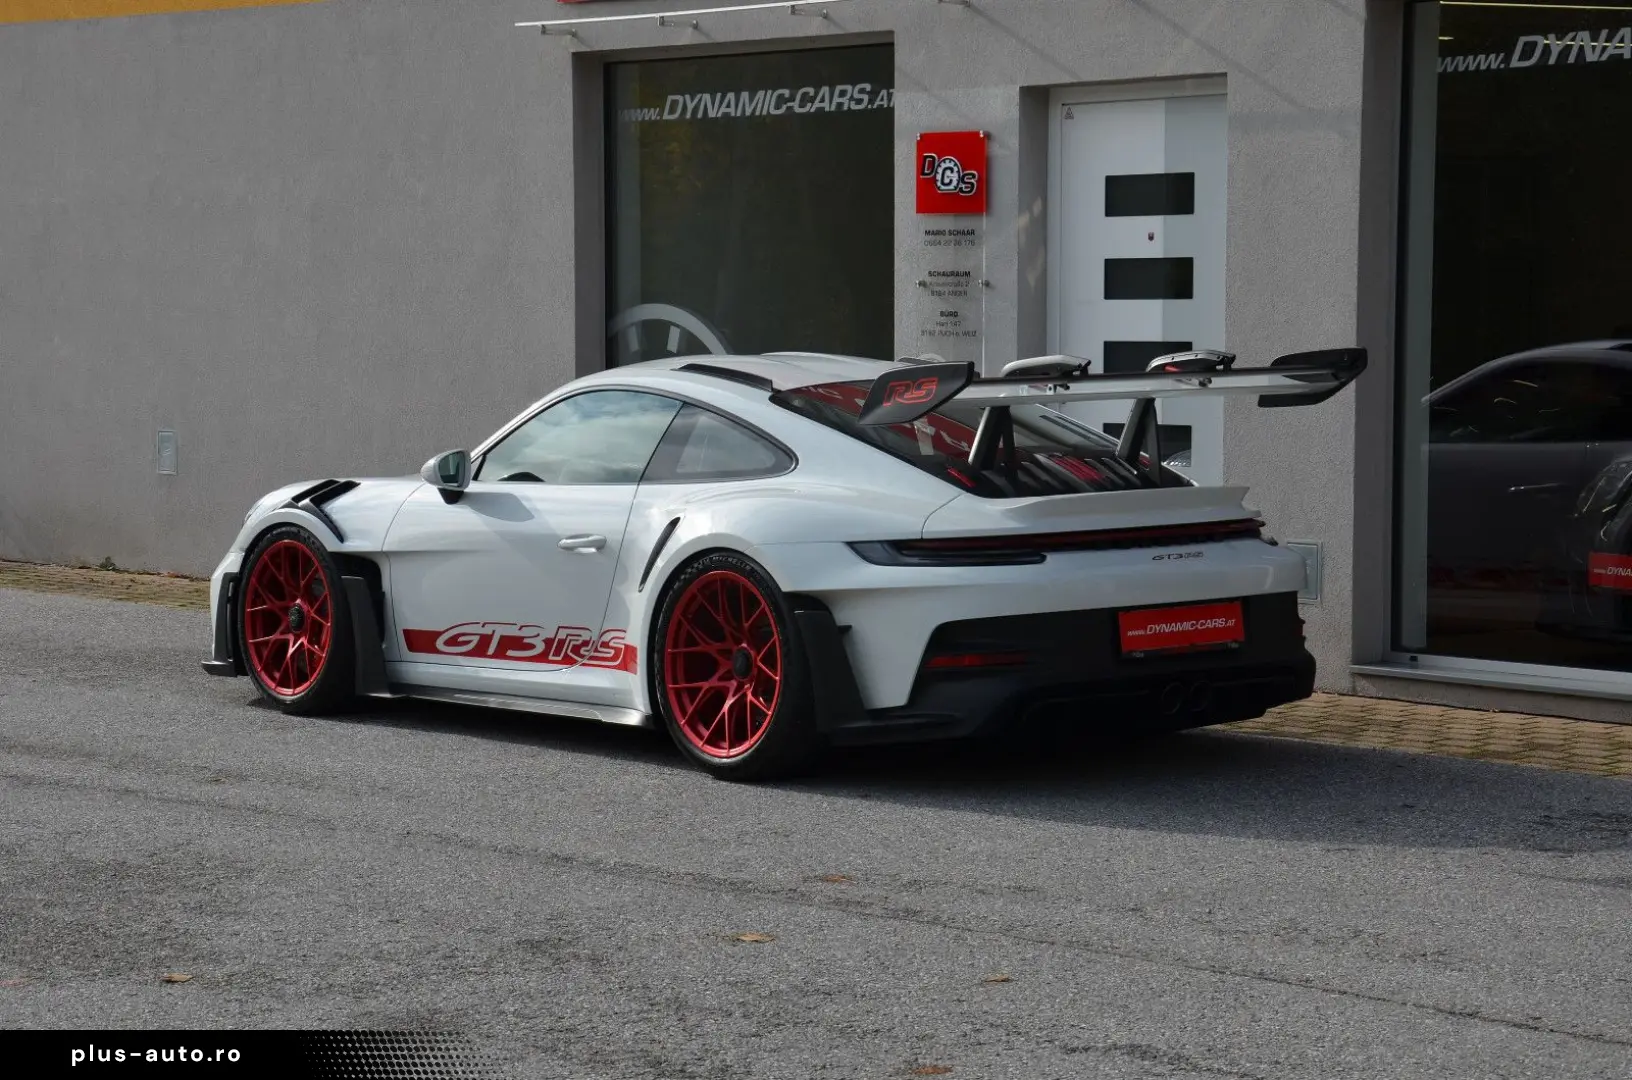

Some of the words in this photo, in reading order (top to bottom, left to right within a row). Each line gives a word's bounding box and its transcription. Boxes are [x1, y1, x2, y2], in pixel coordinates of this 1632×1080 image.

[948, 228, 975, 236] SCHAAR
[928, 270, 971, 278] SCHAURAUM
[883, 377, 939, 406] RS
